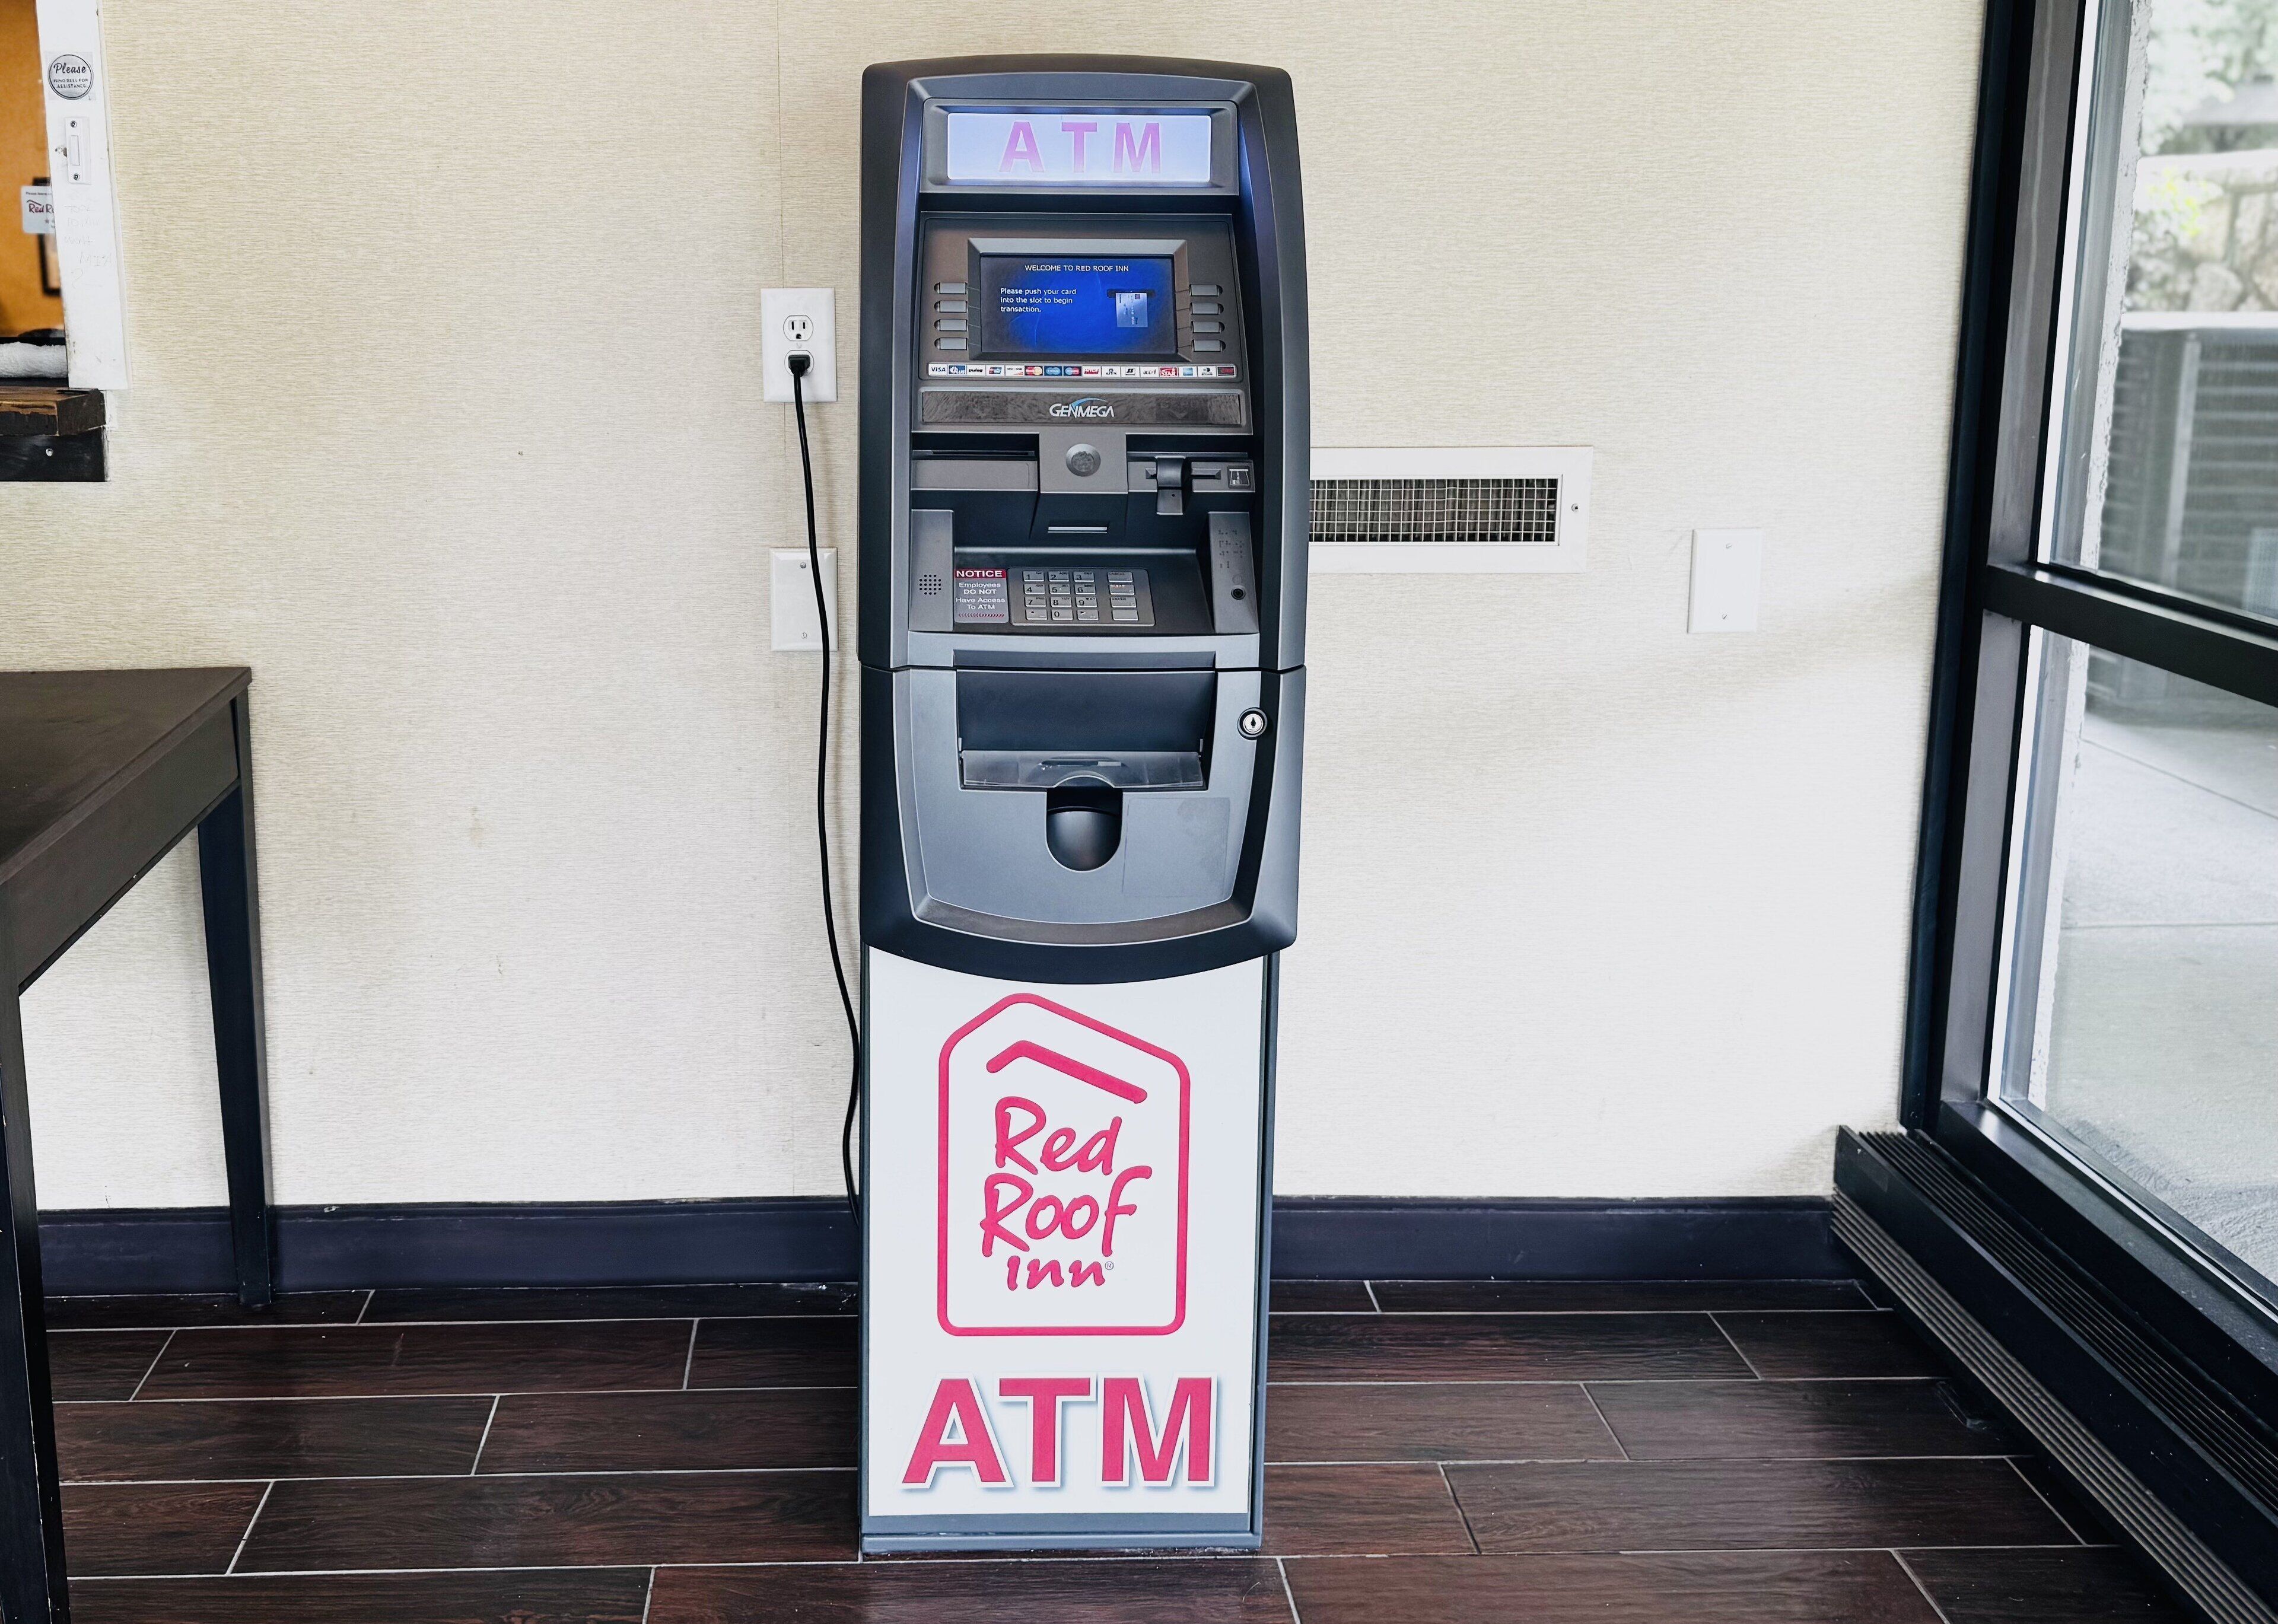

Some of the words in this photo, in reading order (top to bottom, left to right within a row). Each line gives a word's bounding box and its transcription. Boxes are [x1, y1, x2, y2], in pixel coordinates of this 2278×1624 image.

[53, 62, 87, 74] Please
[999, 121, 1161, 173] ATM
[28, 203, 44, 213] Red
[1049, 403, 1115, 418] GENMEGA
[995, 1096, 1122, 1175] Red
[979, 1166, 1153, 1257] Roof
[902, 1376, 1214, 1485] ATM
